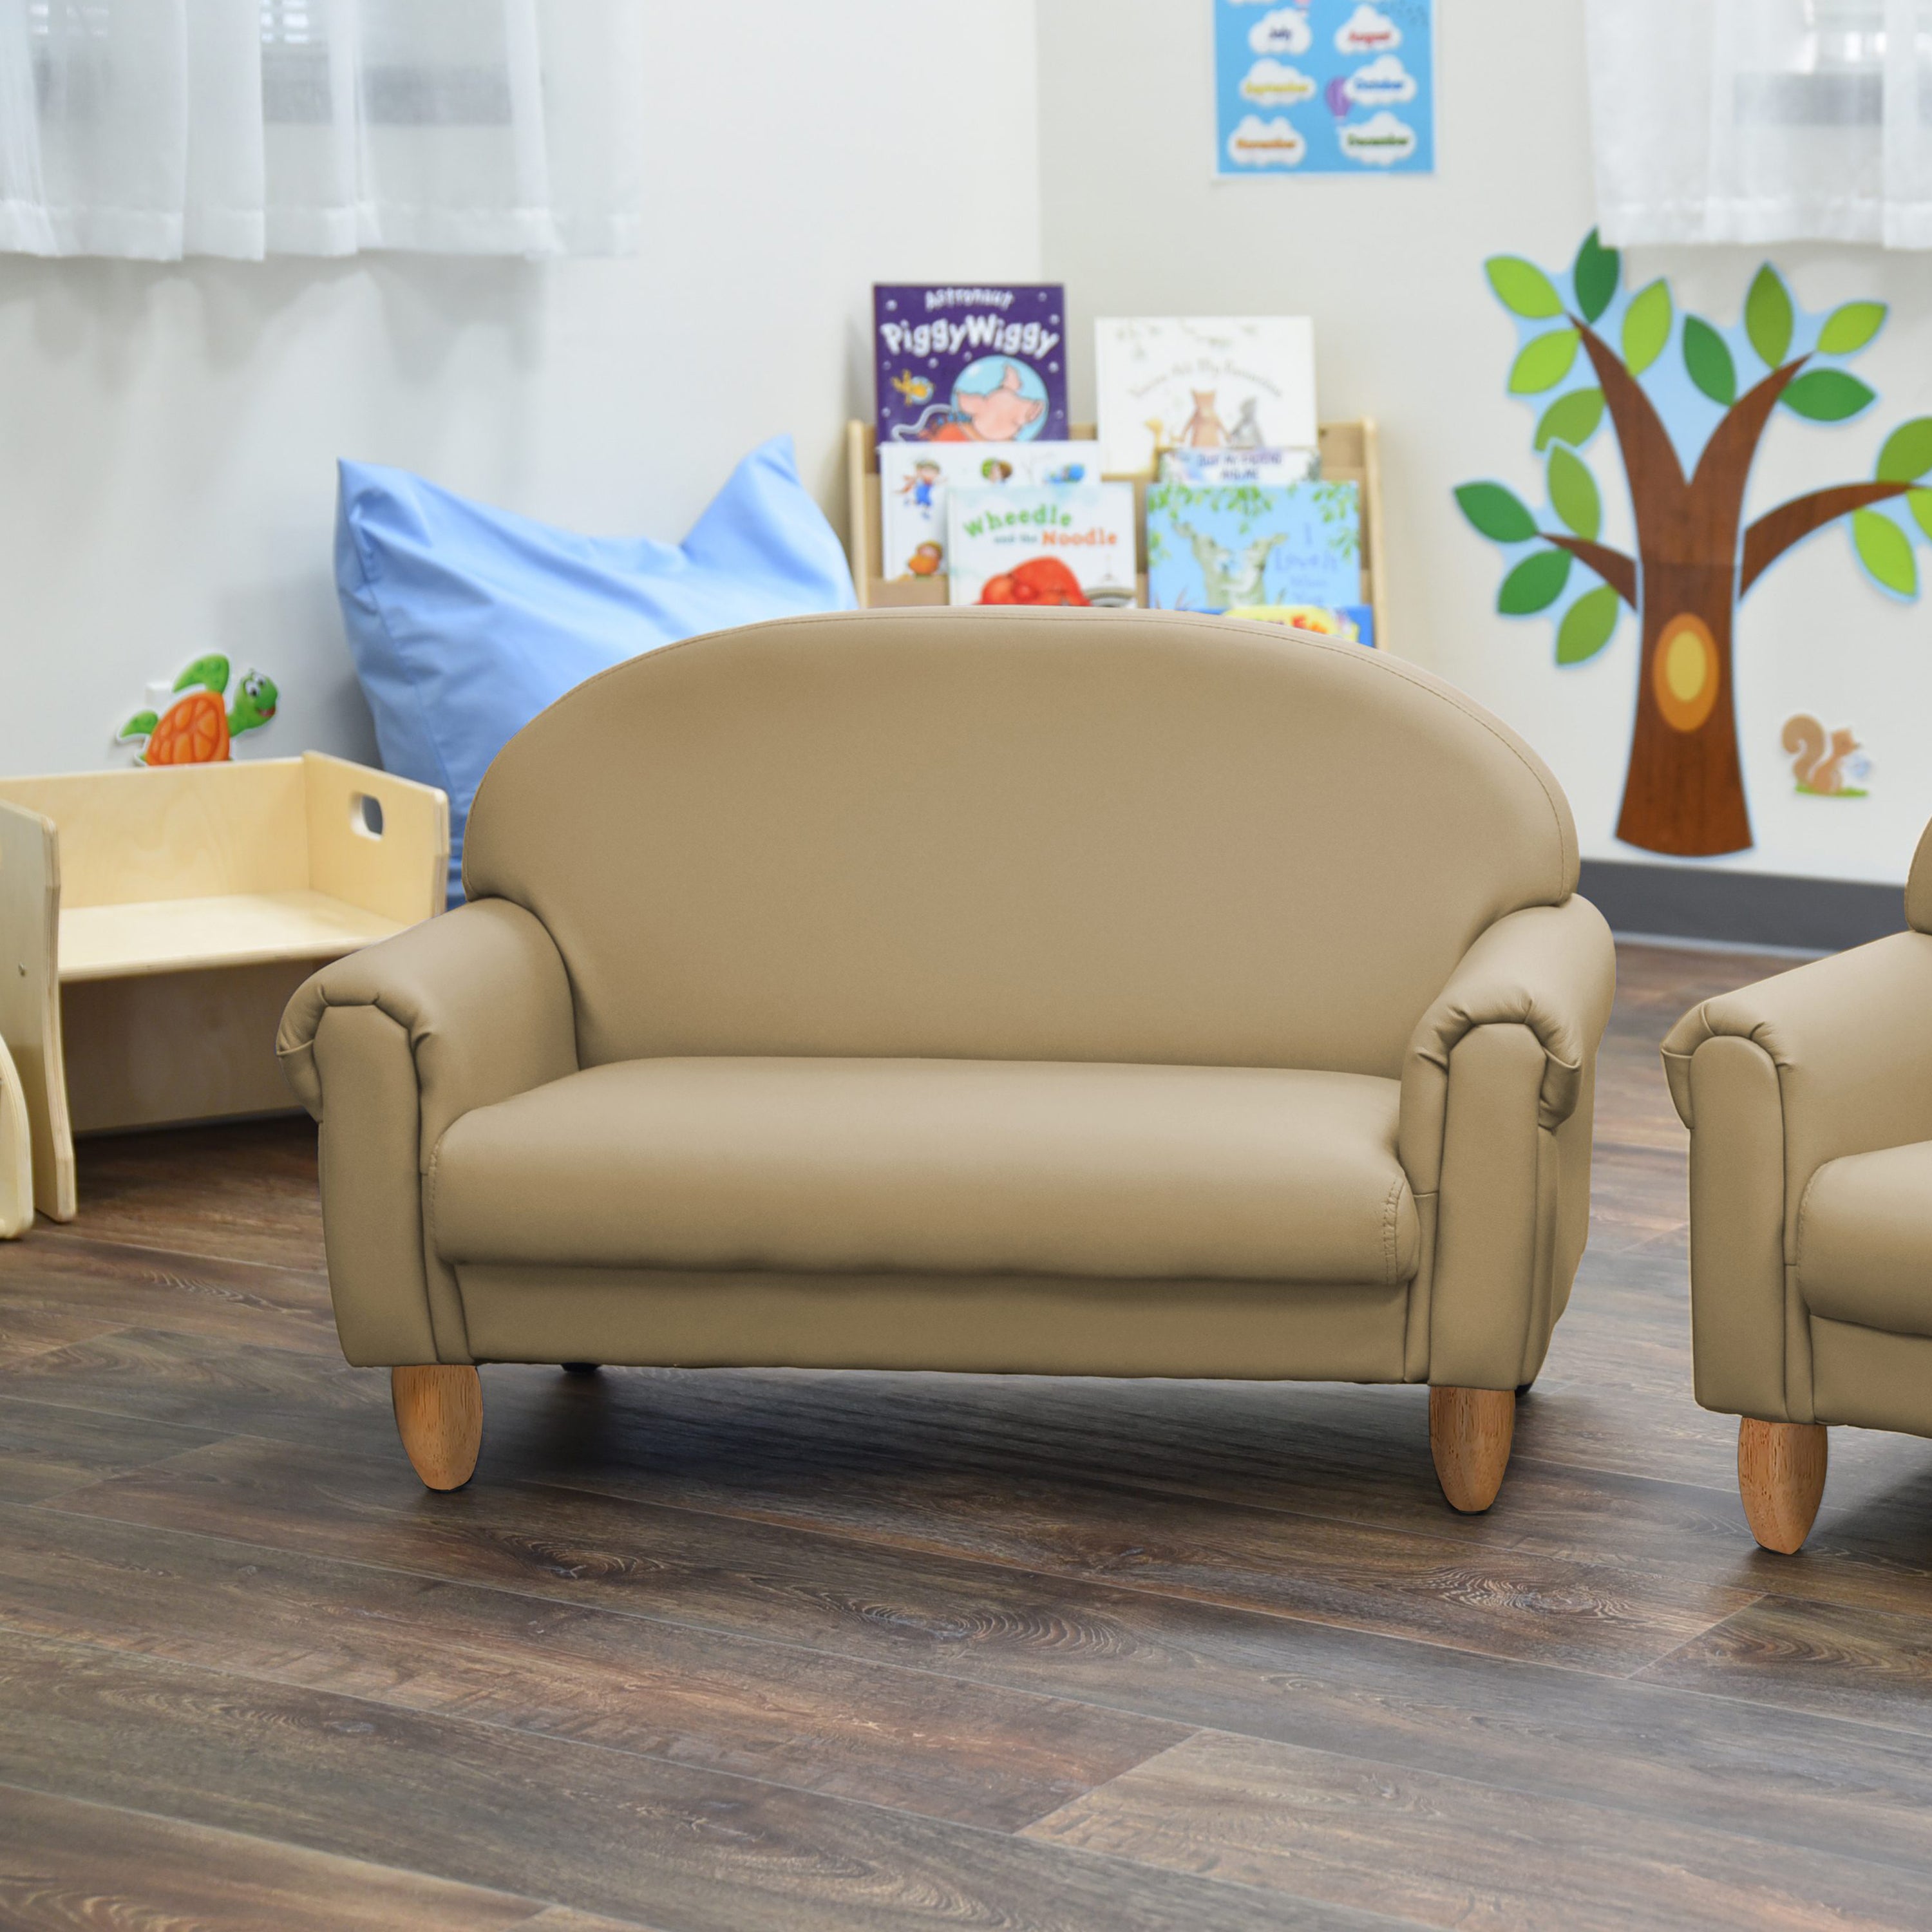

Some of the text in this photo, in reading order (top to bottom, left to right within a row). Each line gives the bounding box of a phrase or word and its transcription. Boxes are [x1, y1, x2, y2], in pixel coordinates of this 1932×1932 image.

[880, 313, 1061, 359] PiggyWiggy
[963, 504, 1072, 537] Wheedle
[1041, 526, 1118, 545] Noodle
